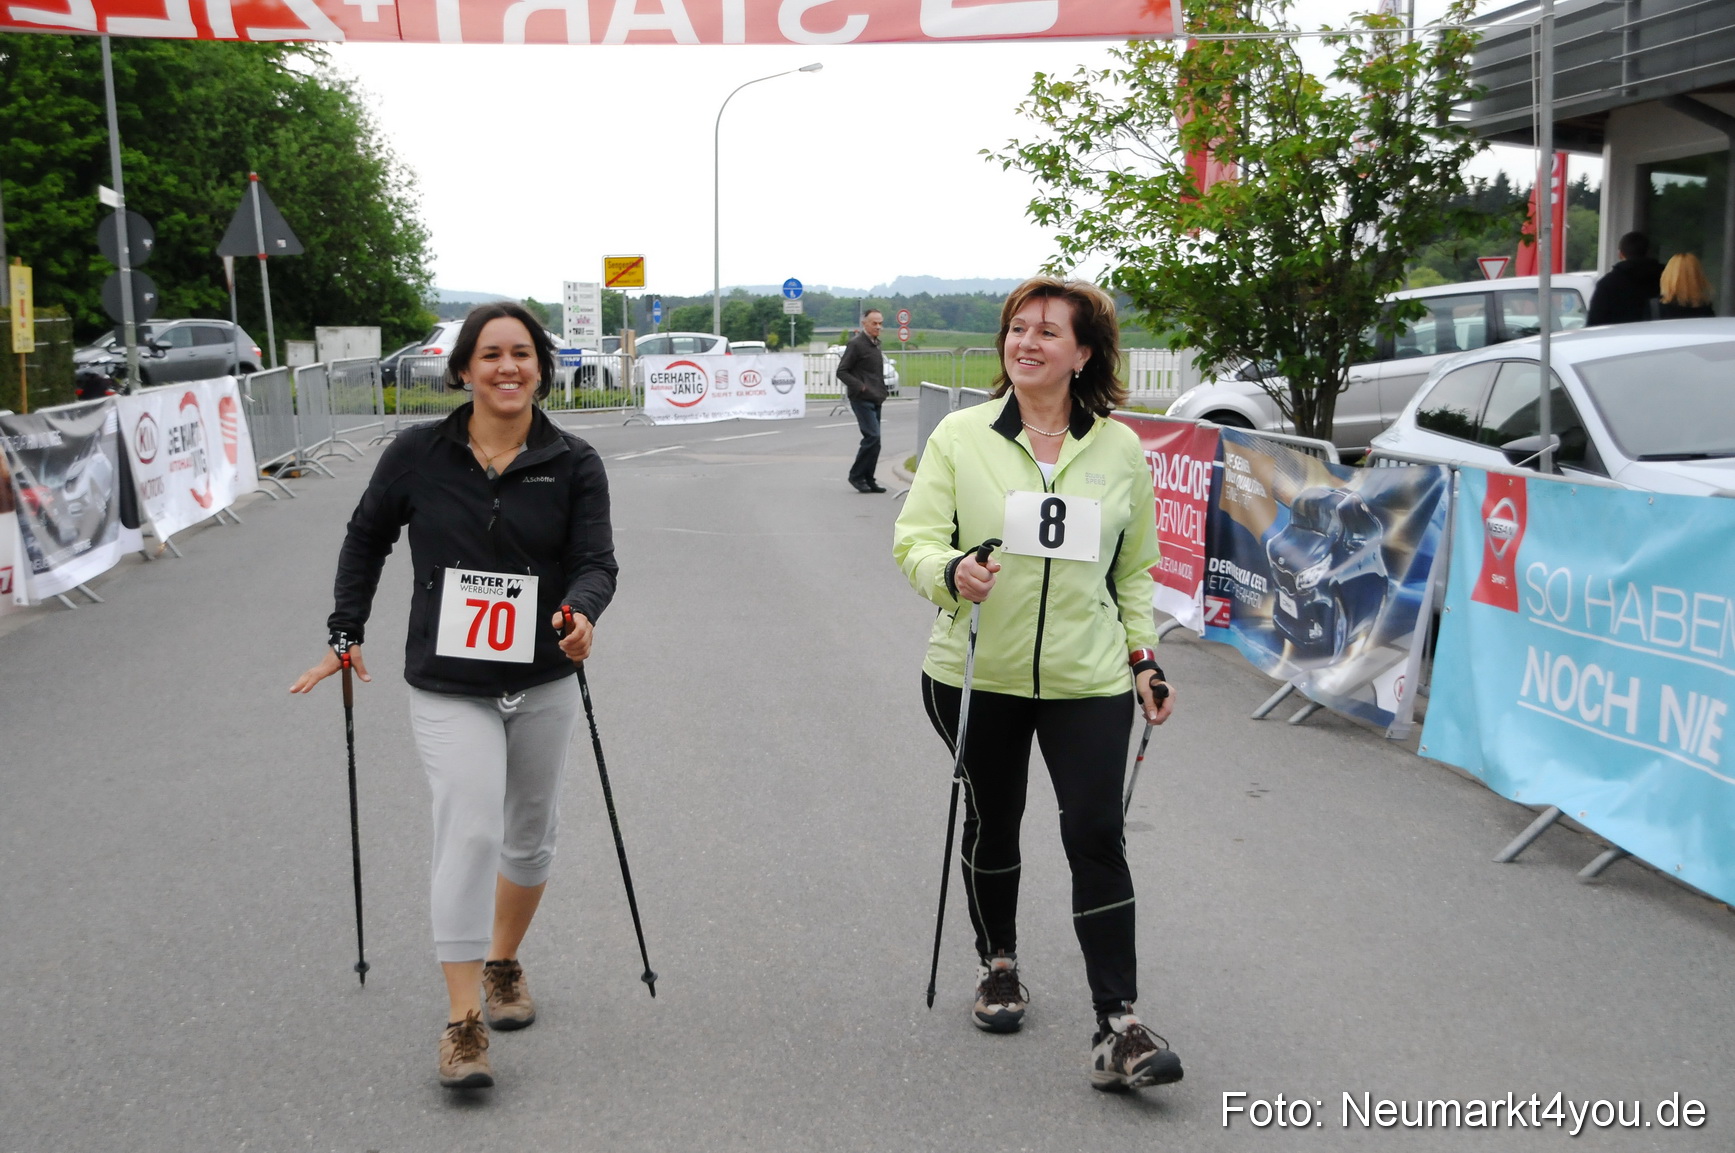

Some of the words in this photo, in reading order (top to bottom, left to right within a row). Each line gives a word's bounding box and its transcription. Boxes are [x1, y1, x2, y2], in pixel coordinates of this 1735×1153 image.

[650, 372, 696, 384] GERHART
[743, 374, 758, 383] KIA
[673, 383, 703, 395] JANIG
[1085, 472, 1105, 480] DOUBLE
[1086, 478, 1106, 486] SPEED
[1038, 497, 1066, 549] 8
[1487, 521, 1513, 536] NISSAN
[460, 574, 503, 587] MEYER
[460, 584, 503, 596] WERBUNG
[1526, 562, 1571, 622] SO
[465, 598, 516, 651] 70
[1519, 645, 1641, 735] NOCH
[1658, 683, 1728, 766] NIE
